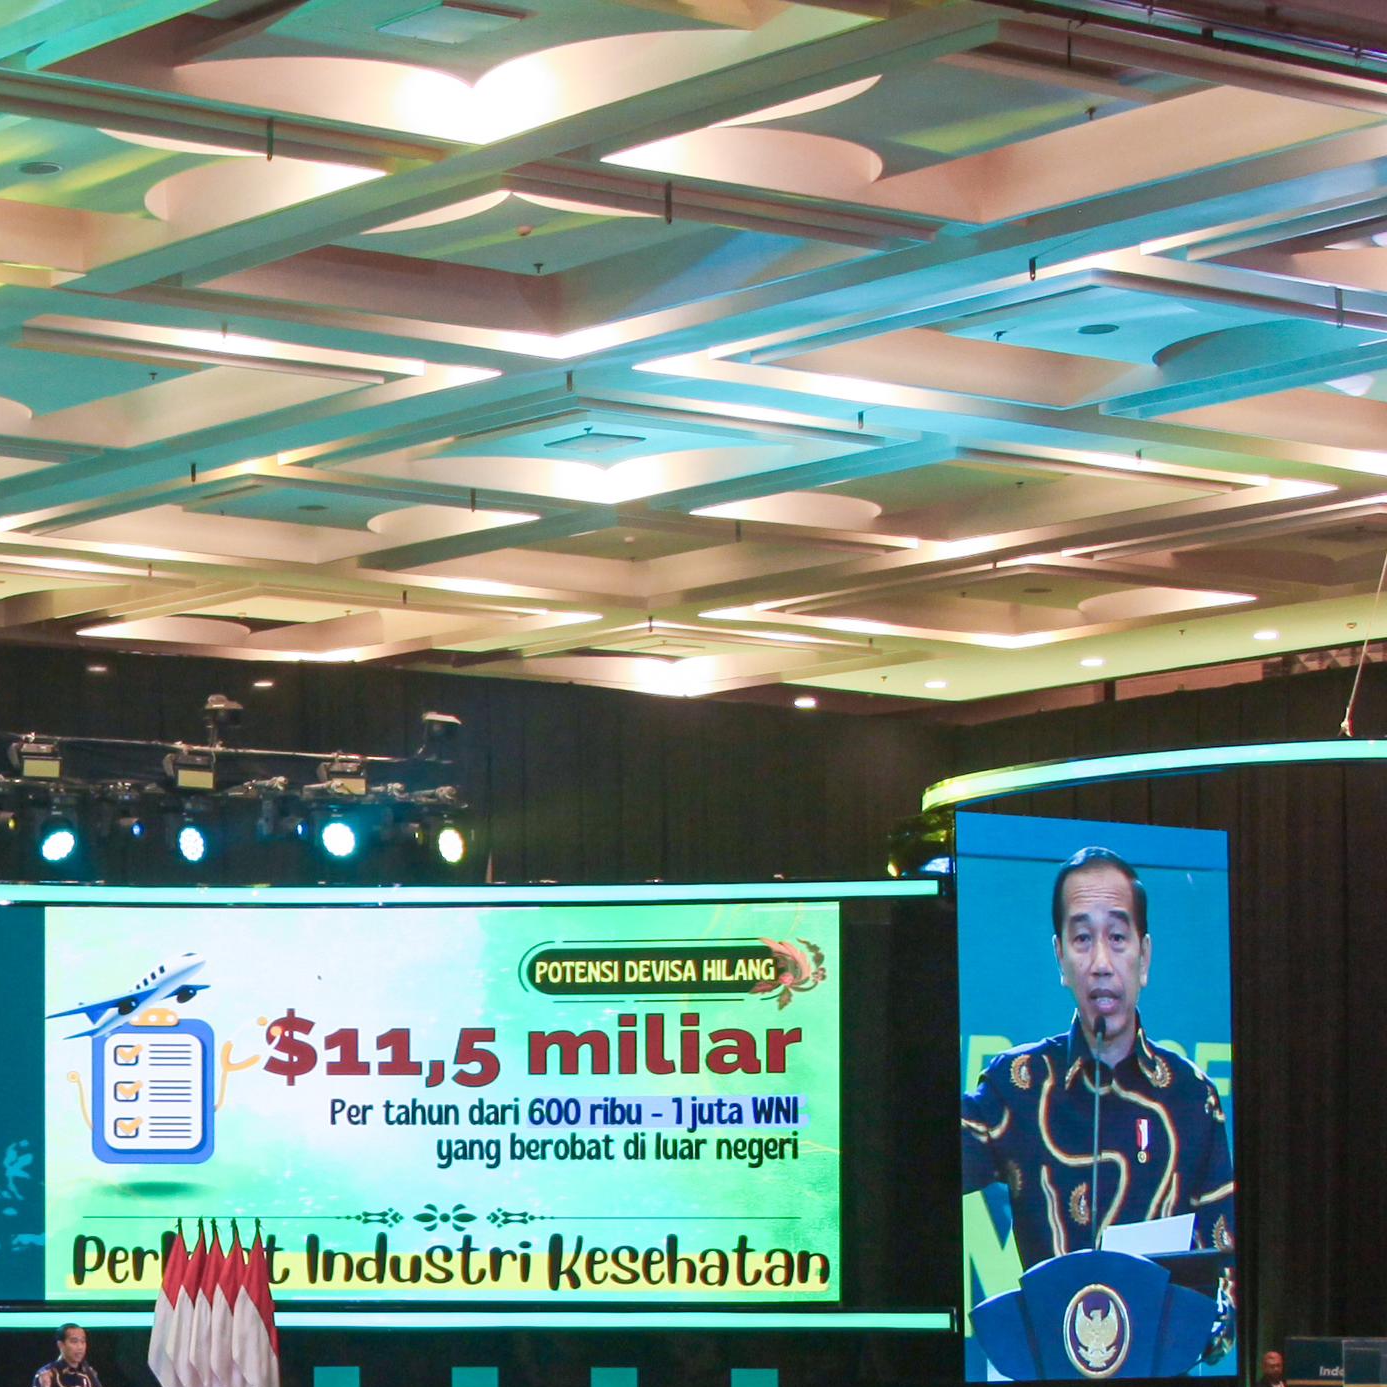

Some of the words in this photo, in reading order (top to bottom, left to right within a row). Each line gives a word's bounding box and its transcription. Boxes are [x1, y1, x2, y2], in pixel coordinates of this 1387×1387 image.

[534, 959, 622, 984] POTENSI
[624, 959, 699, 984] DEVISA
[702, 959, 776, 984] HILANG
[262, 1008, 501, 1088] $11,5
[527, 1012, 802, 1075] miliar
[330, 1098, 374, 1125] Per
[382, 1098, 461, 1126] tahun
[468, 1098, 520, 1126] dari
[528, 1097, 581, 1126] 600
[589, 1097, 643, 1126] ribu
[752, 1098, 800, 1125] WNI
[436, 1139, 502, 1170] yang
[509, 1132, 616, 1161] berobat
[624, 1132, 648, 1161] di
[655, 1132, 709, 1161] luar
[716, 1133, 799, 1170] negeri
[72, 1234, 291, 1288] Pert
[308, 1233, 532, 1285] Industri
[548, 1234, 830, 1291] Kesehatan
